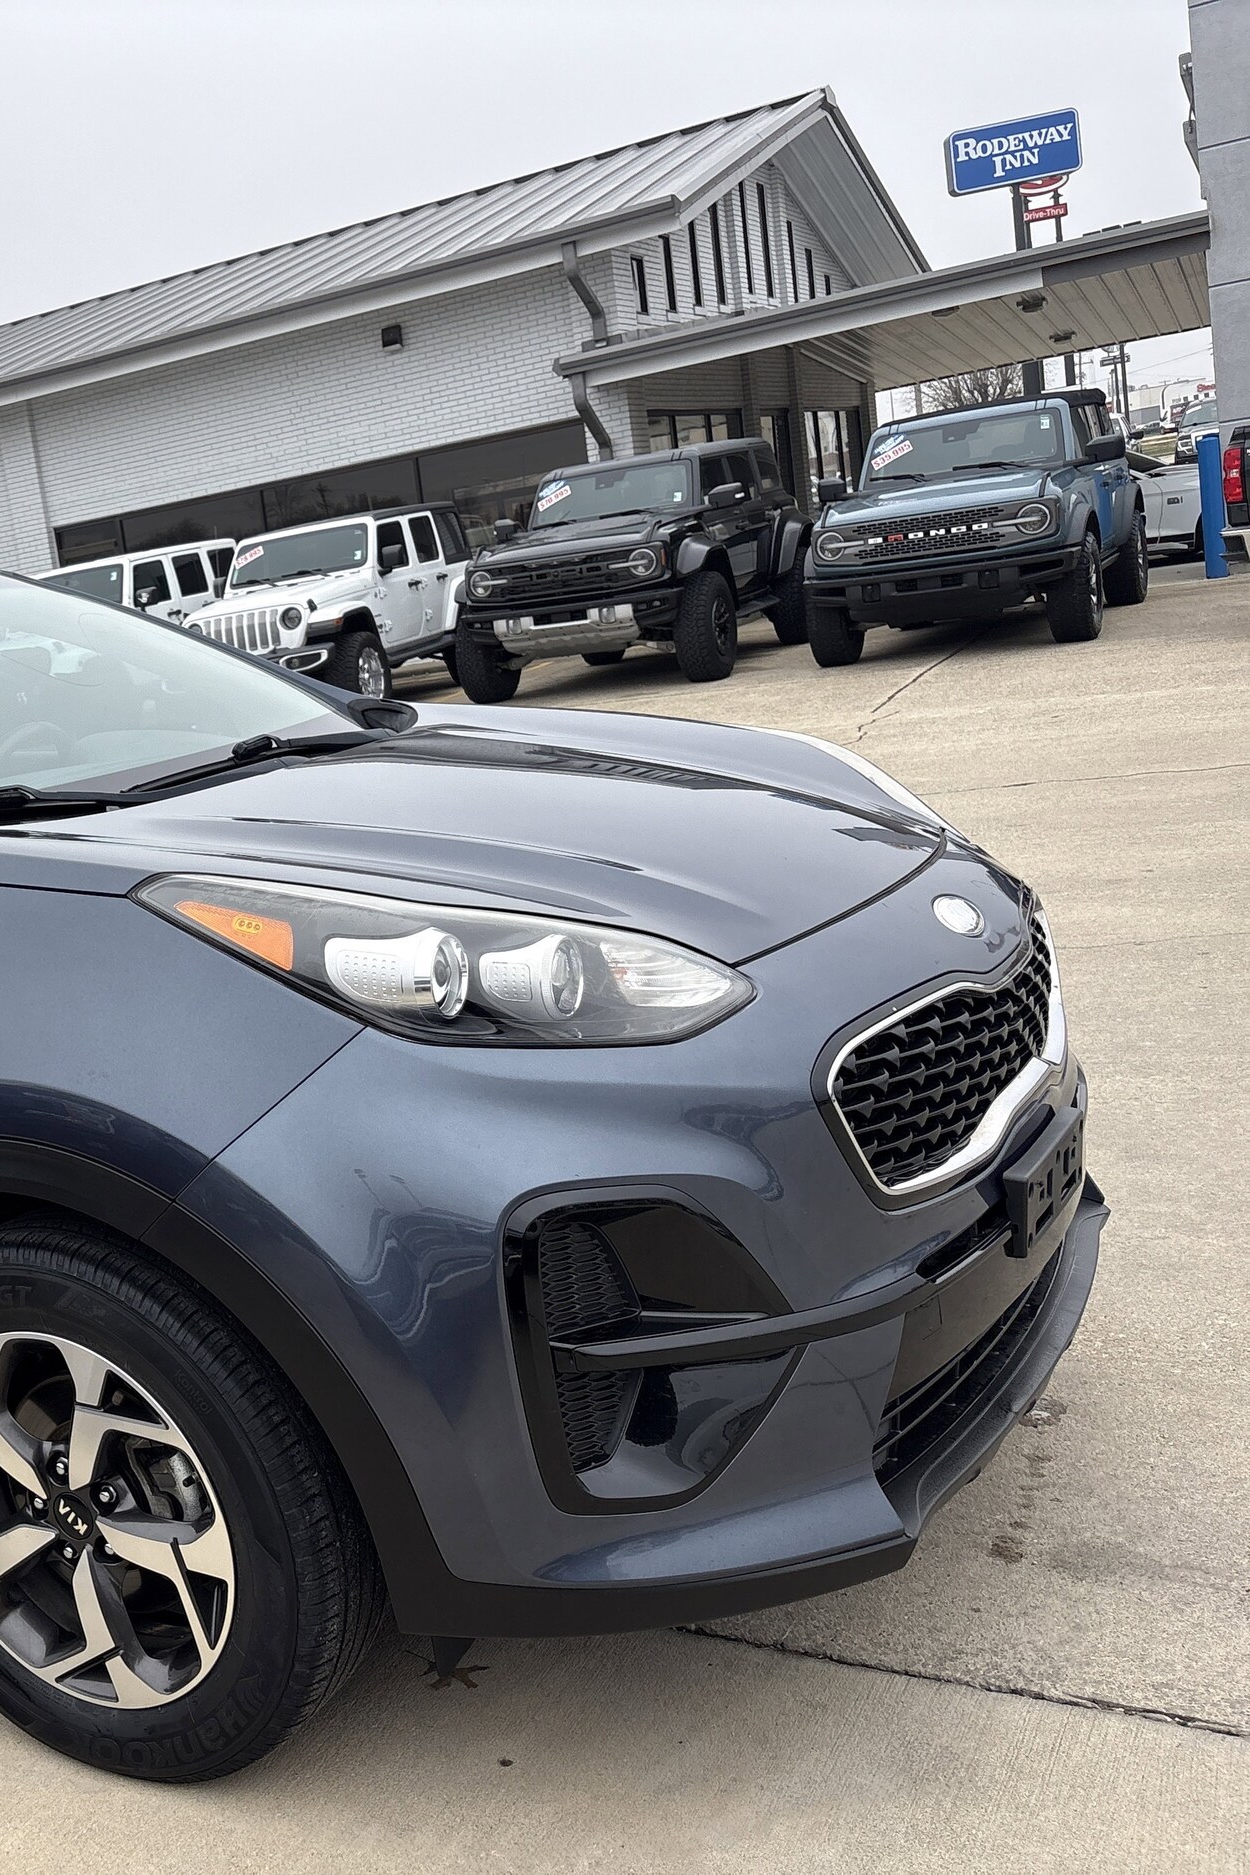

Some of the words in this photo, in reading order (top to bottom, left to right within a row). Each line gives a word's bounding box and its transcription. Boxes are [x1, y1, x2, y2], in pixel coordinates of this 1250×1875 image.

[955, 123, 1074, 162] RODEWAY
[992, 149, 1040, 178] INN
[1023, 208, 1065, 221] Drive-Thru
[867, 522, 989, 545] BRONCO
[58, 1498, 89, 1536] KIA
